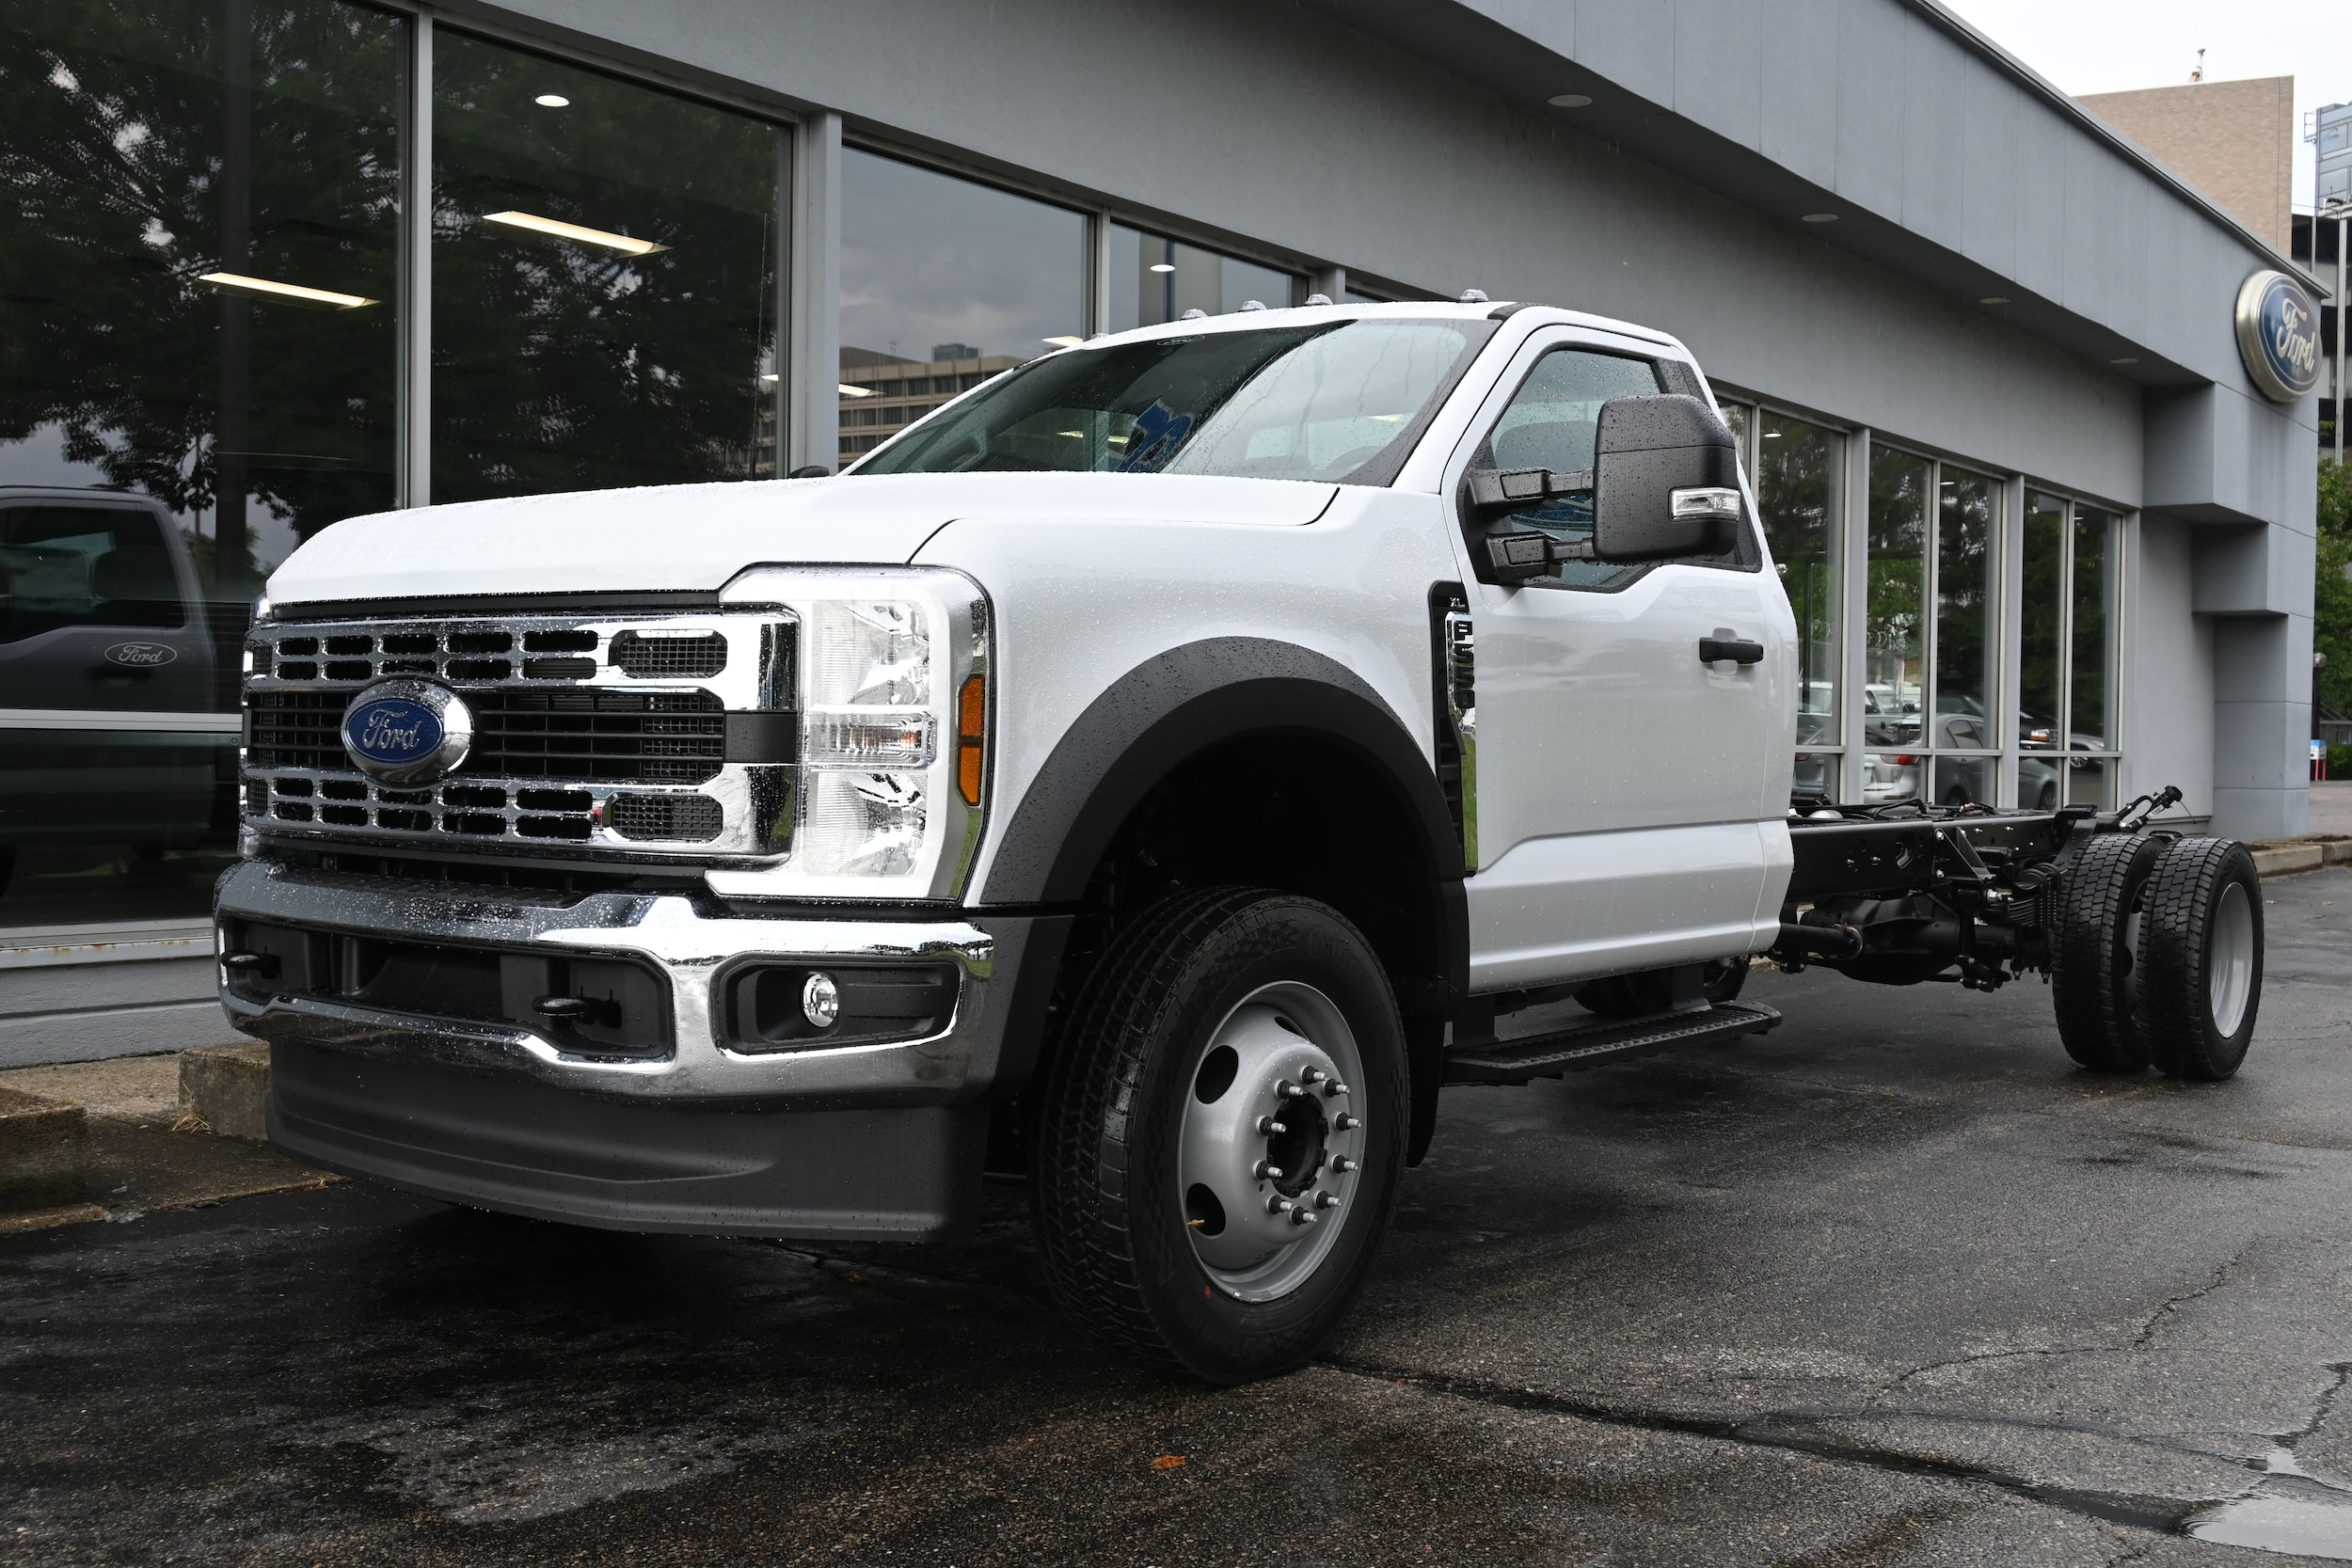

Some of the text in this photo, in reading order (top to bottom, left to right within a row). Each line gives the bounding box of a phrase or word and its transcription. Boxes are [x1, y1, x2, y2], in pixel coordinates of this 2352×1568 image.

[2276, 297, 2316, 373] Ford
[1449, 596, 1466, 608] XL
[119, 644, 163, 663] Ford
[362, 708, 422, 751] Ford
